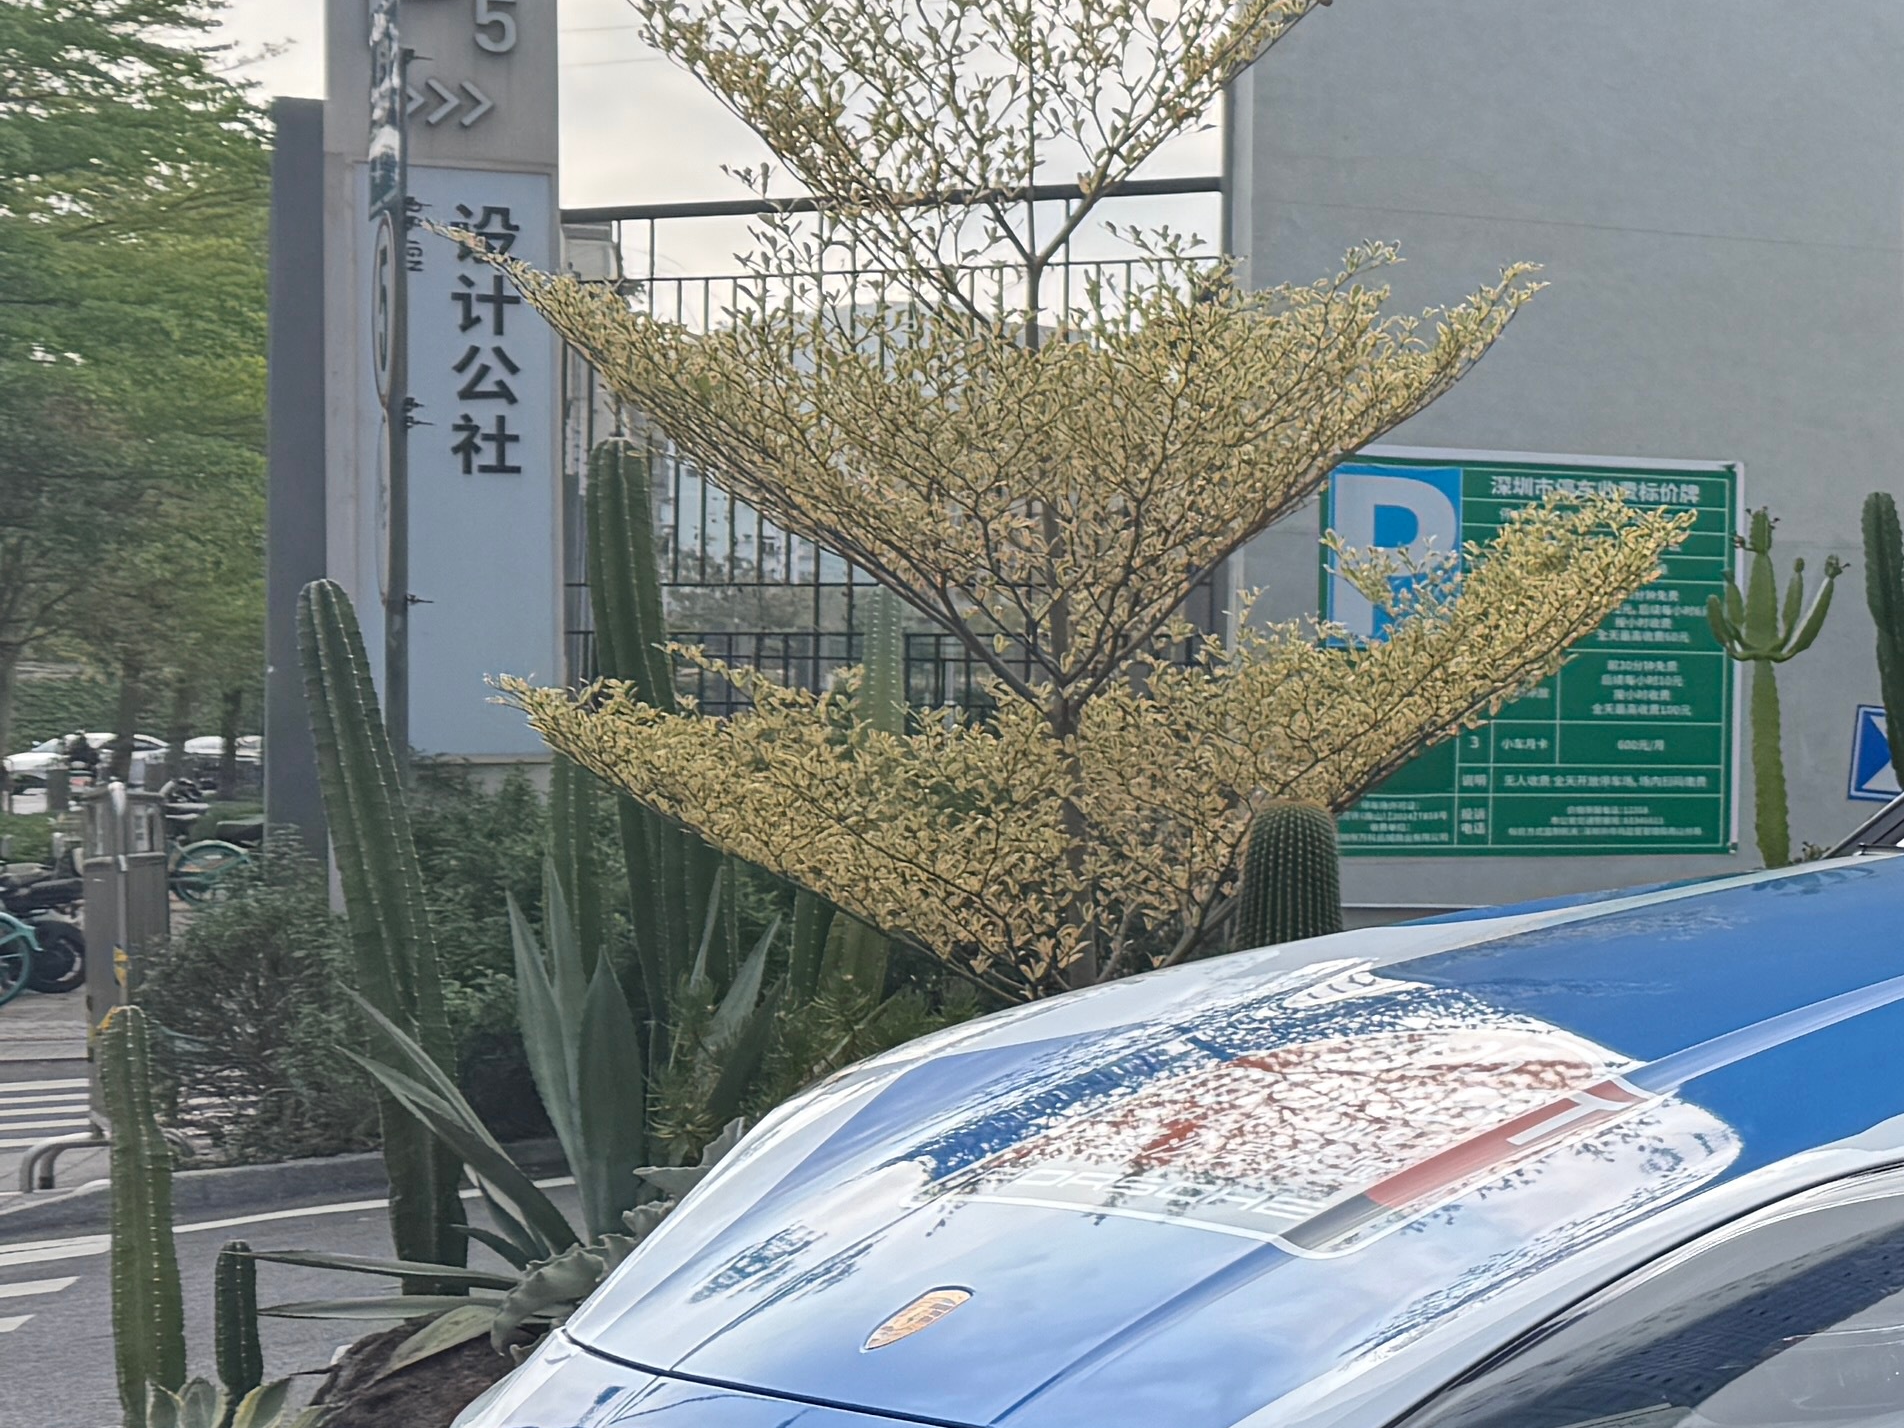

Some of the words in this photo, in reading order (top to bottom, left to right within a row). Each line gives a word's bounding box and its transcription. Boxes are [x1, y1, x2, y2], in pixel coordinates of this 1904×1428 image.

[451, 203, 522, 475] 设计公社
[1335, 474, 1457, 639] P
[1470, 735, 1480, 749] 3
